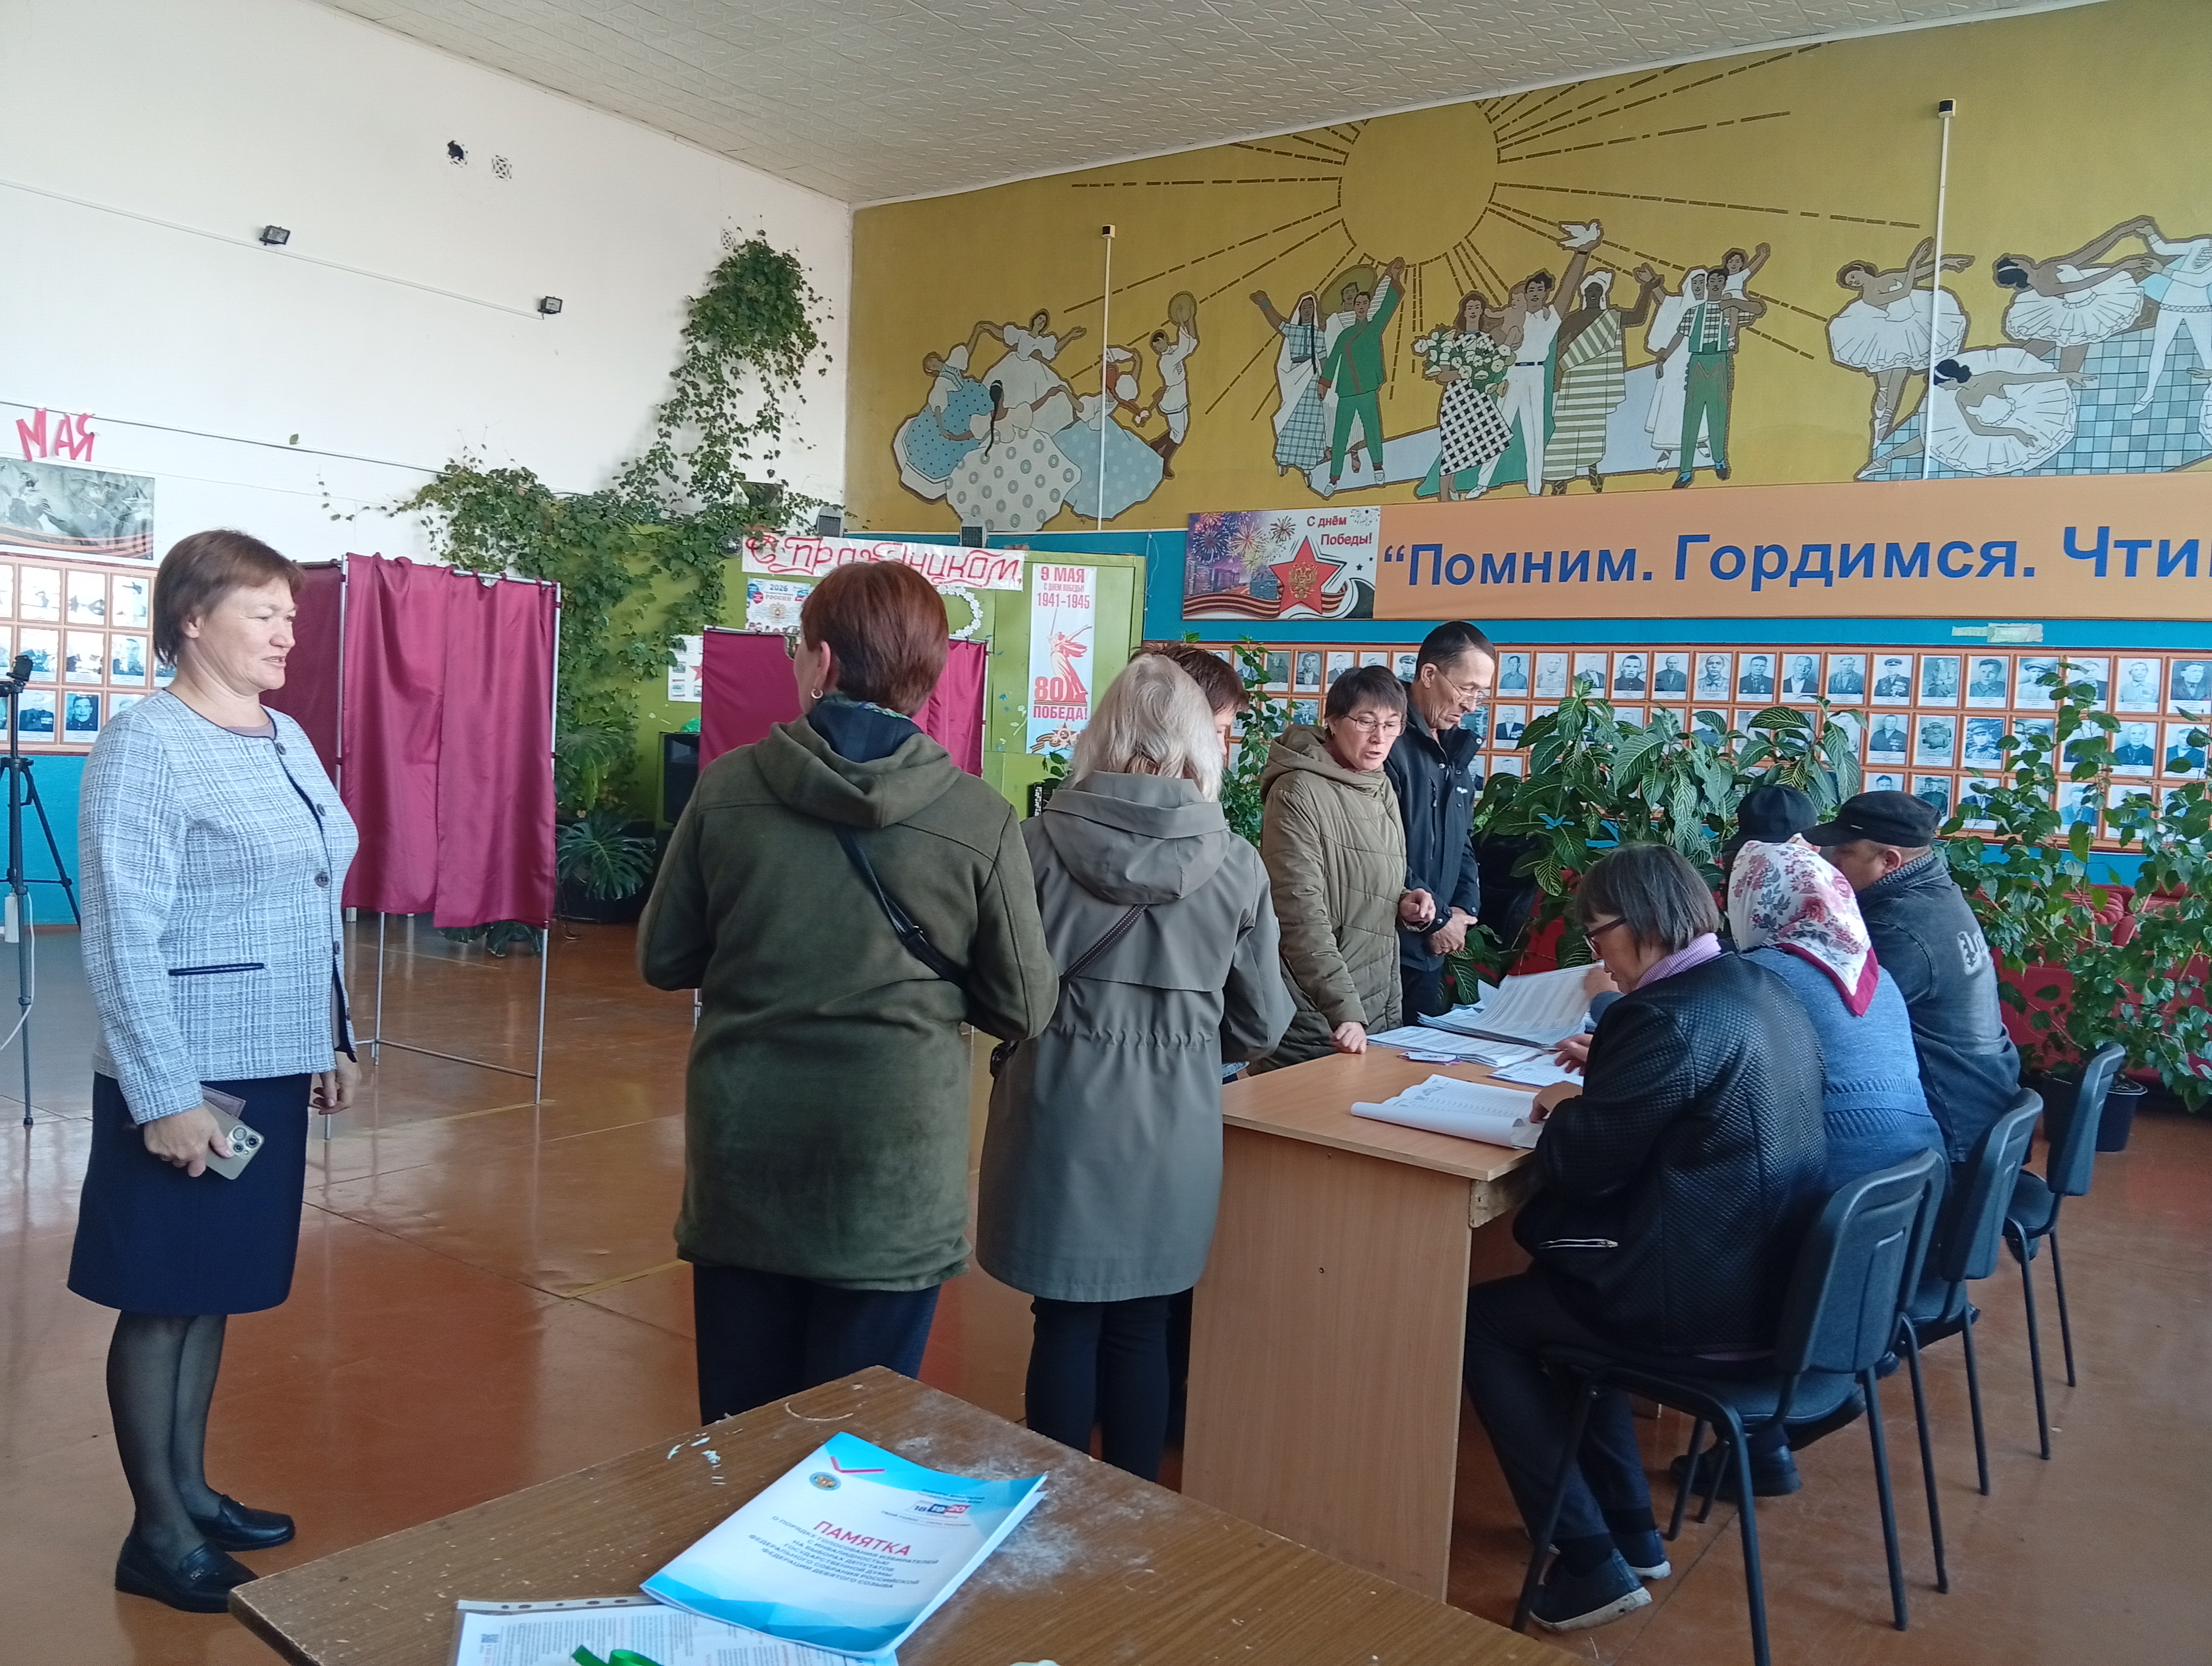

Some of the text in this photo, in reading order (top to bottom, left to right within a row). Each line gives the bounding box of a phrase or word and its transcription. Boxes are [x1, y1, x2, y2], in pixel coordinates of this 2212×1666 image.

[16, 408, 95, 462] МАЯ
[1307, 516, 1347, 528] С днём
[1321, 533, 1372, 546] Победы!
[1674, 534, 2035, 592] Гордимся.
[2062, 526, 2212, 578] Чти
[1041, 567, 1084, 582] 9 МАЯ
[1034, 676, 1064, 701] 80
[1033, 706, 1088, 721] ПОБЕДА!
[779, 1518, 818, 1538] ПОРЯДКЕ
[817, 1536, 878, 1557] ГОЛОСОВАНИЯ
[813, 1521, 911, 1555] ПАМЯТКА
[749, 1534, 920, 1584] ФЕДЕРАЛЬНОГО СОБРАНИЯ РОССИЙСКОЙ
[784, 1543, 866, 1572] ГОСУДАРСТВЕННОЙ
[805, 1546, 844, 1561] ВЫБОРАХ
[845, 1559, 895, 1572] ДЕПУТАТОВ
[814, 1543, 890, 1565] ИНВАЛИДНОСТЬЮ
[762, 1548, 893, 1588] ФЕДЕРАЦИИ ДЕВЯТОГО СОЗЫВА
